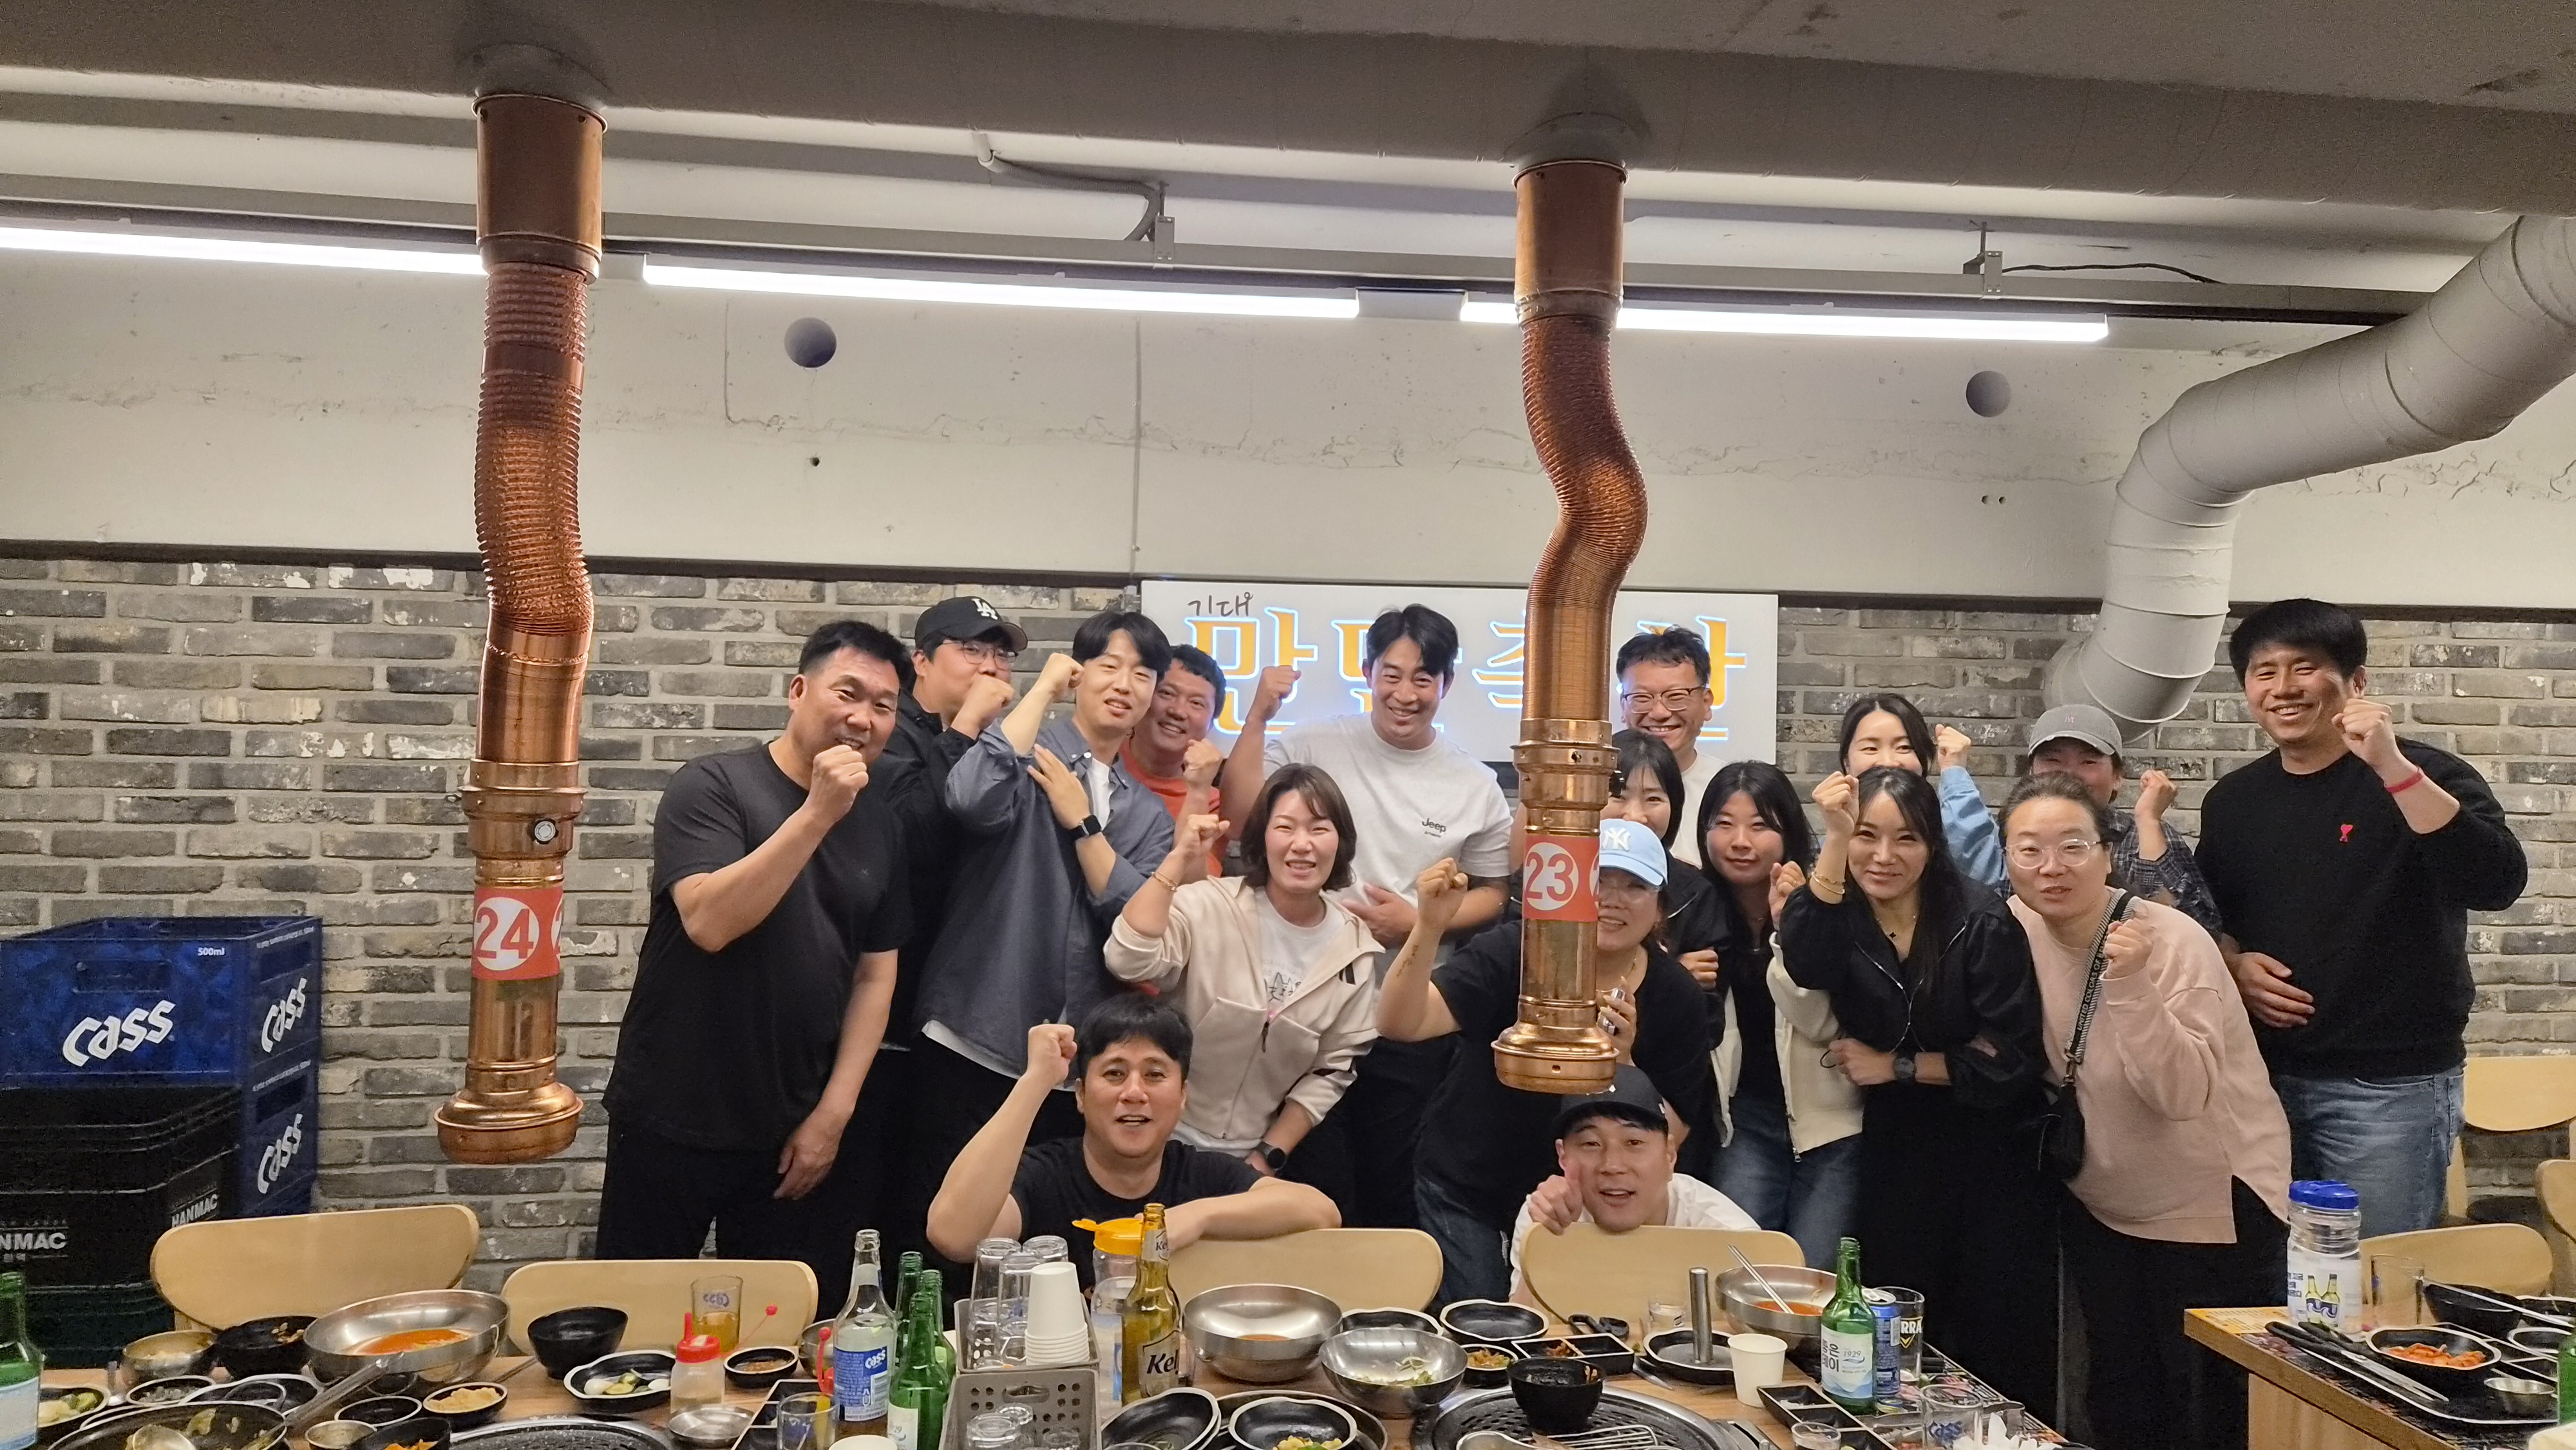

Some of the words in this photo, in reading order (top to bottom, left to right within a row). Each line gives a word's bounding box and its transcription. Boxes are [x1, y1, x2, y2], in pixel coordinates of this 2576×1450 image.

[971, 598, 998, 620] LA
[1422, 818, 1446, 833] Jeep
[1602, 827, 1631, 851] NY
[1524, 851, 1574, 901] 23
[474, 907, 534, 959] 24
[2078, 1004, 2089, 1030] UNITED
[0, 1232, 67, 1250] NMAC
[1900, 1320, 1922, 1334] RRA
